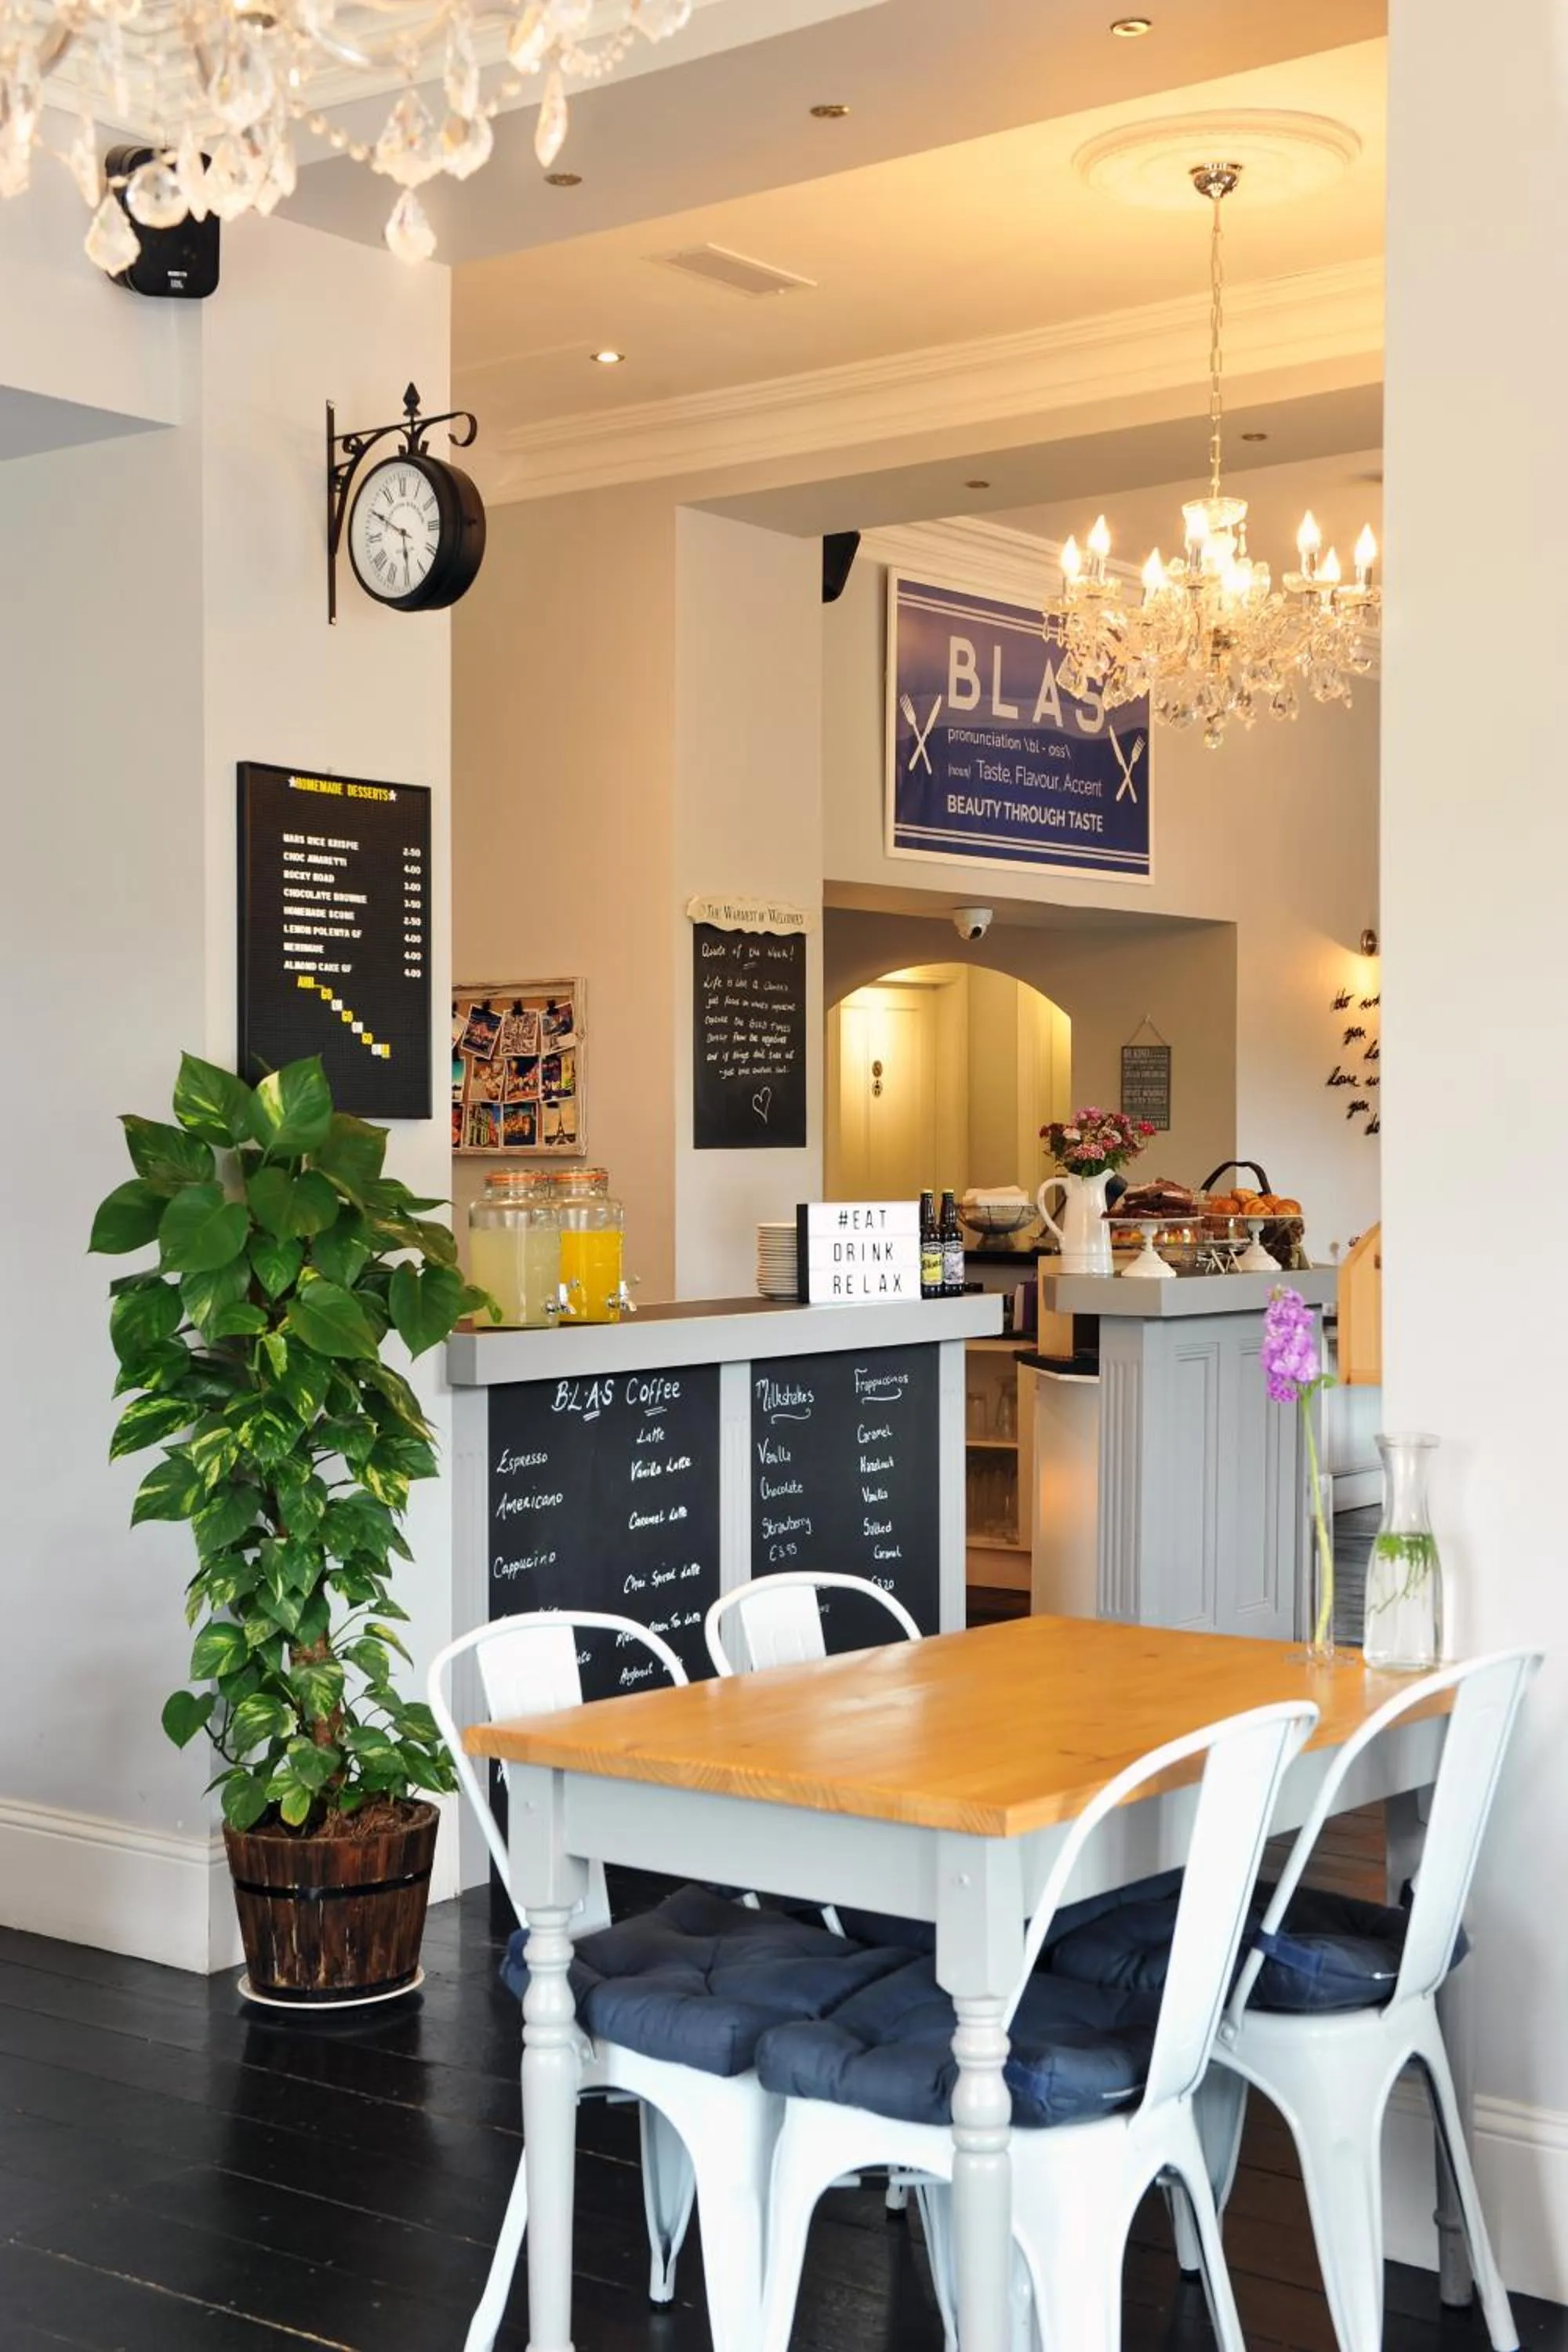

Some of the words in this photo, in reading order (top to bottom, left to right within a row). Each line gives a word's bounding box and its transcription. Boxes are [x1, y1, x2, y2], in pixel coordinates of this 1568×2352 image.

[948, 636, 1105, 733] BLAS
[948, 728, 1022, 750] pronunciation
[975, 759, 1012, 785] Taste,
[1016, 767, 1062, 792] Flavour,
[1064, 774, 1102, 797] Accent
[347, 784, 389, 801] DESSERTS
[947, 794, 1002, 818] BEAUTY
[1004, 802, 1065, 827] THROUGH
[1069, 811, 1104, 832] TASTE
[283, 851, 305, 862] CHOC
[283, 869, 311, 880] ROCKY
[312, 872, 335, 884] ROAD
[283, 887, 332, 901] CHOCOLATE
[283, 906, 327, 919] HOMEMADE
[283, 924, 312, 935] LEMON
[314, 926, 350, 938] POLENTA
[283, 960, 318, 972] ALMOND
[318, 962, 340, 973] CAKE
[703, 975, 722, 990] Life
[838, 1210, 887, 1230] #EAT
[833, 1243, 894, 1263] DRINK
[833, 1274, 902, 1295] RELAX
[625, 1377, 681, 1406] Coffee
[756, 1378, 815, 1412] Milkshakes
[636, 1427, 665, 1443] Latte
[496, 1448, 548, 1475] Espresso
[759, 1476, 804, 1500] Chocolate
[495, 1489, 563, 1521] Americano
[761, 1516, 813, 1539] Strawberry
[863, 1517, 892, 1537] Salted
